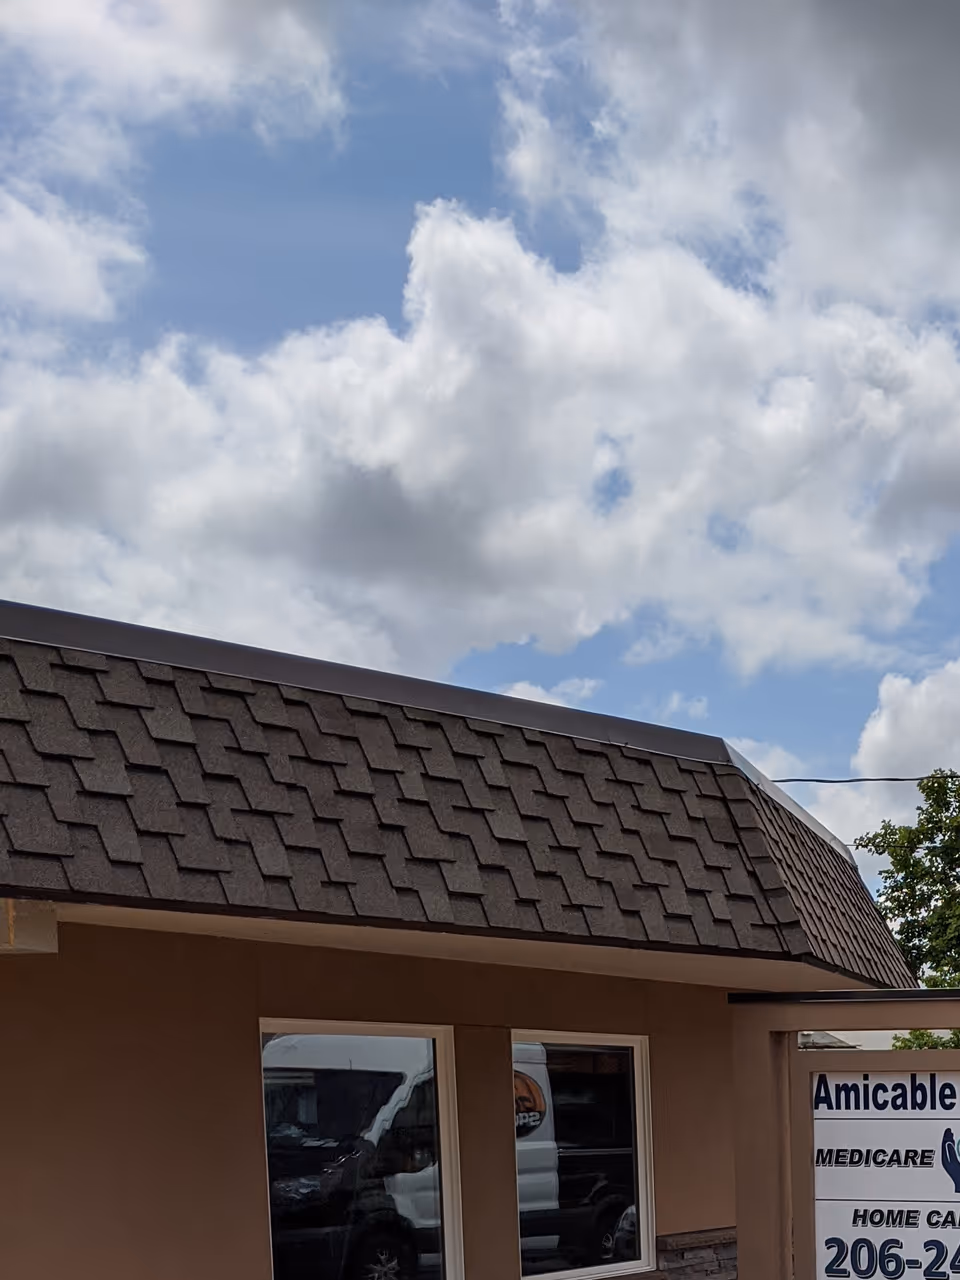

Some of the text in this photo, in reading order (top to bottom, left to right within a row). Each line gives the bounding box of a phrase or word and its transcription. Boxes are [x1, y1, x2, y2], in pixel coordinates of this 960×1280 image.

[814, 1073, 957, 1111] Amicable
[815, 1149, 936, 1168] MEDICARE
[852, 1209, 920, 1228] HOME
